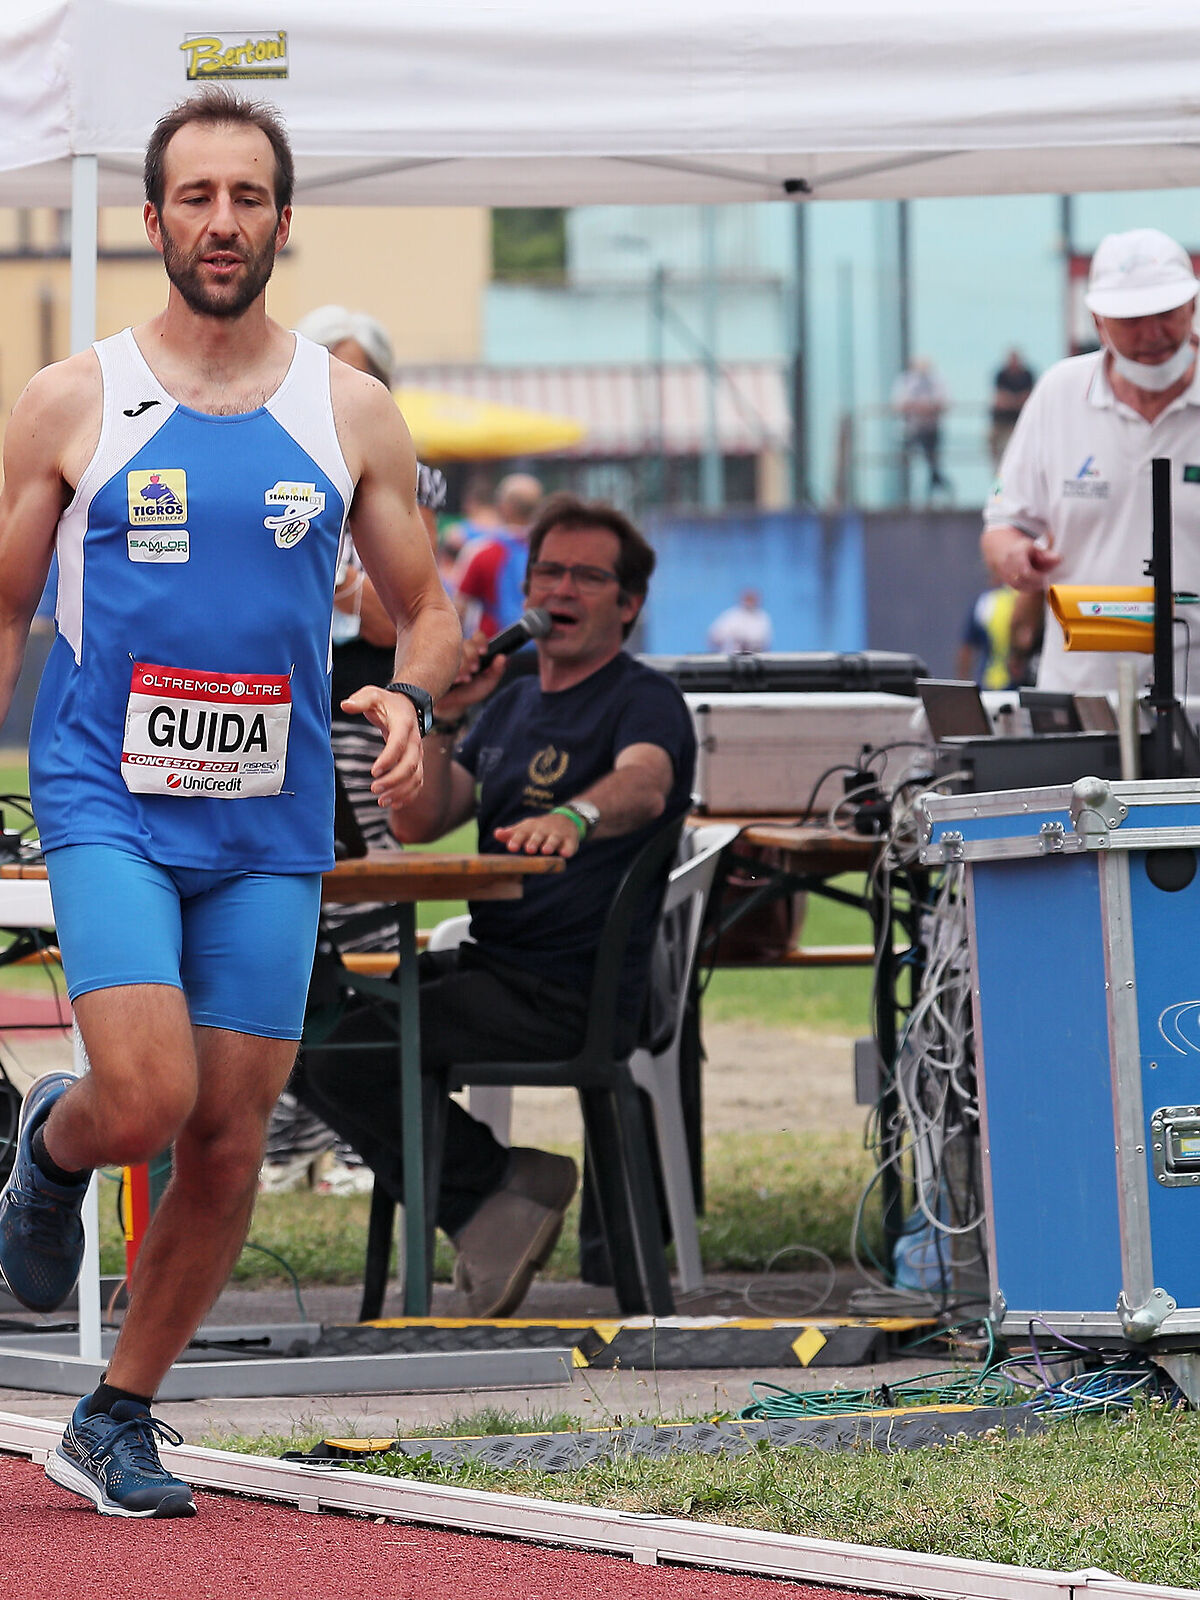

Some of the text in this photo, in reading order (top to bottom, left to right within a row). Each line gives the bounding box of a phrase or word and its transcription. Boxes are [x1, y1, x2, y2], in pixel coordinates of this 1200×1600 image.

[180, 31, 286, 77] Bertoni
[269, 494, 309, 502] SEMPIONE
[133, 505, 183, 516] TIGROS
[129, 540, 188, 549] SAMLOR
[147, 705, 268, 754] GUIDA
[127, 754, 237, 772] CONCESIO 2021
[183, 775, 242, 792] UniCredit
